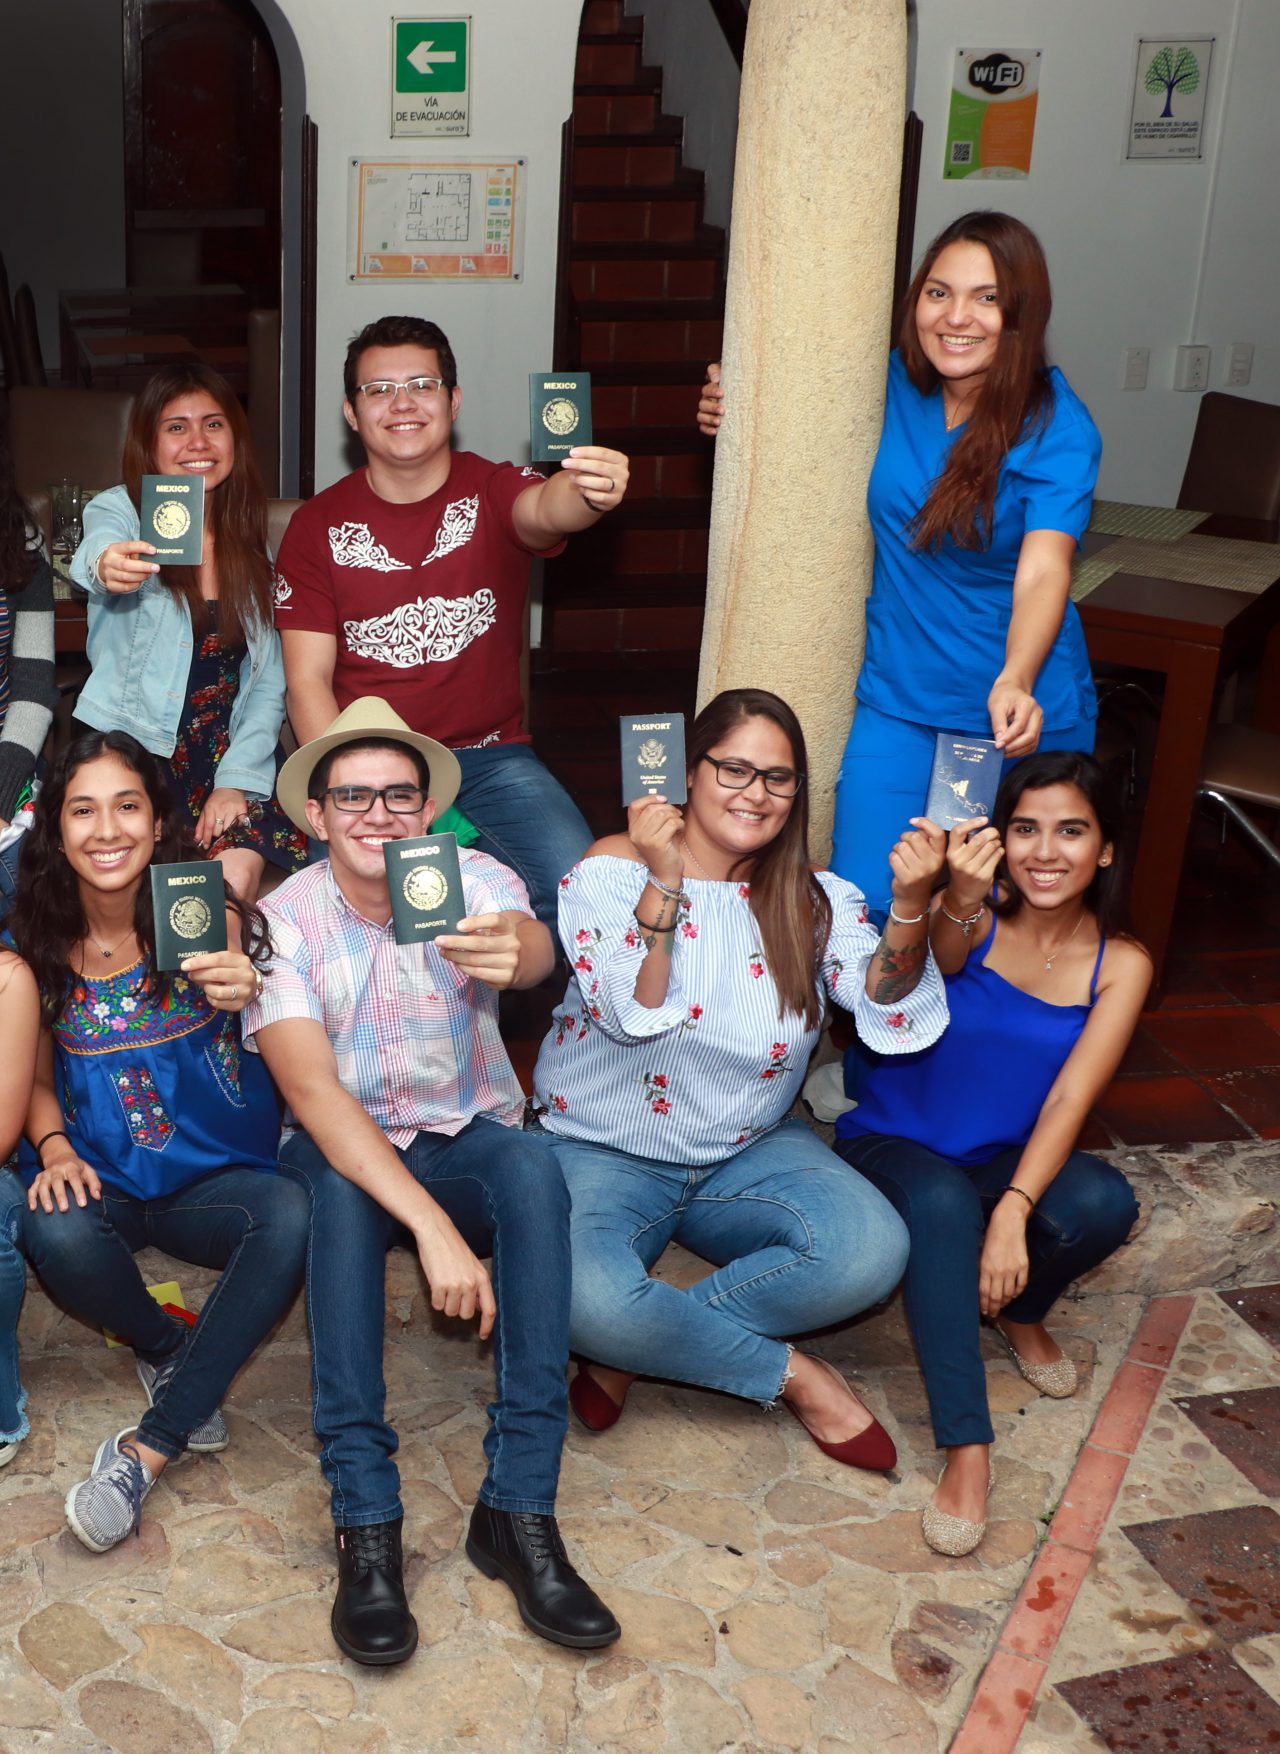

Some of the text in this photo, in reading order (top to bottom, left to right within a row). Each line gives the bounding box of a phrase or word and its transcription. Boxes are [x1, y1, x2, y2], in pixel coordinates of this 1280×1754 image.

[974, 66, 1018, 82] WiFi
[424, 96, 438, 107] VÍA
[396, 110, 466, 121] DE EVACUACIÓN
[543, 382, 577, 390] MEXICO
[156, 485, 190, 493] MEXICO
[632, 723, 671, 731] PASSPORT
[400, 845, 441, 860] MEXICO
[167, 875, 207, 887] MEXICO
[414, 919, 447, 929] PASAPORTE
